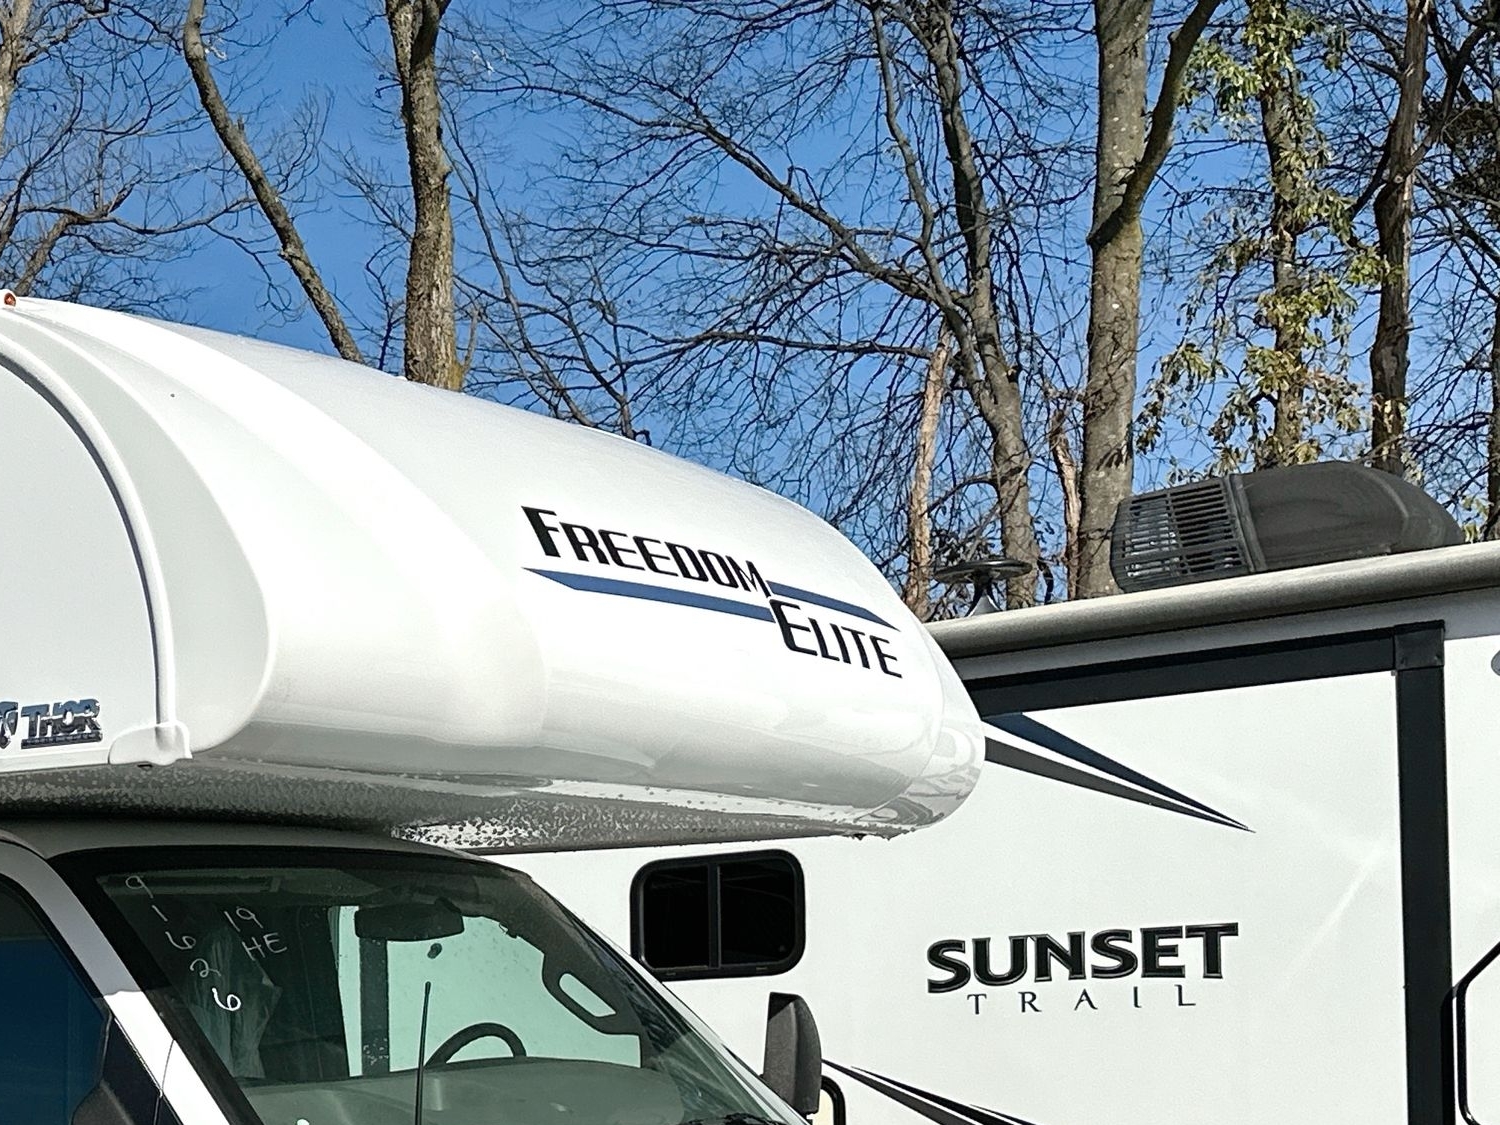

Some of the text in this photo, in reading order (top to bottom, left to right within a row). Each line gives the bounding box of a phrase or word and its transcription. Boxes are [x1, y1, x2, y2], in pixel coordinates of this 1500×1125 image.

[521, 505, 772, 599] FREEDOM
[769, 598, 903, 679] ELITE
[20, 698, 103, 738] THOR
[241, 932, 288, 962] HE
[927, 922, 1239, 994] SUNSET
[966, 985, 1197, 1015] TRAIL
